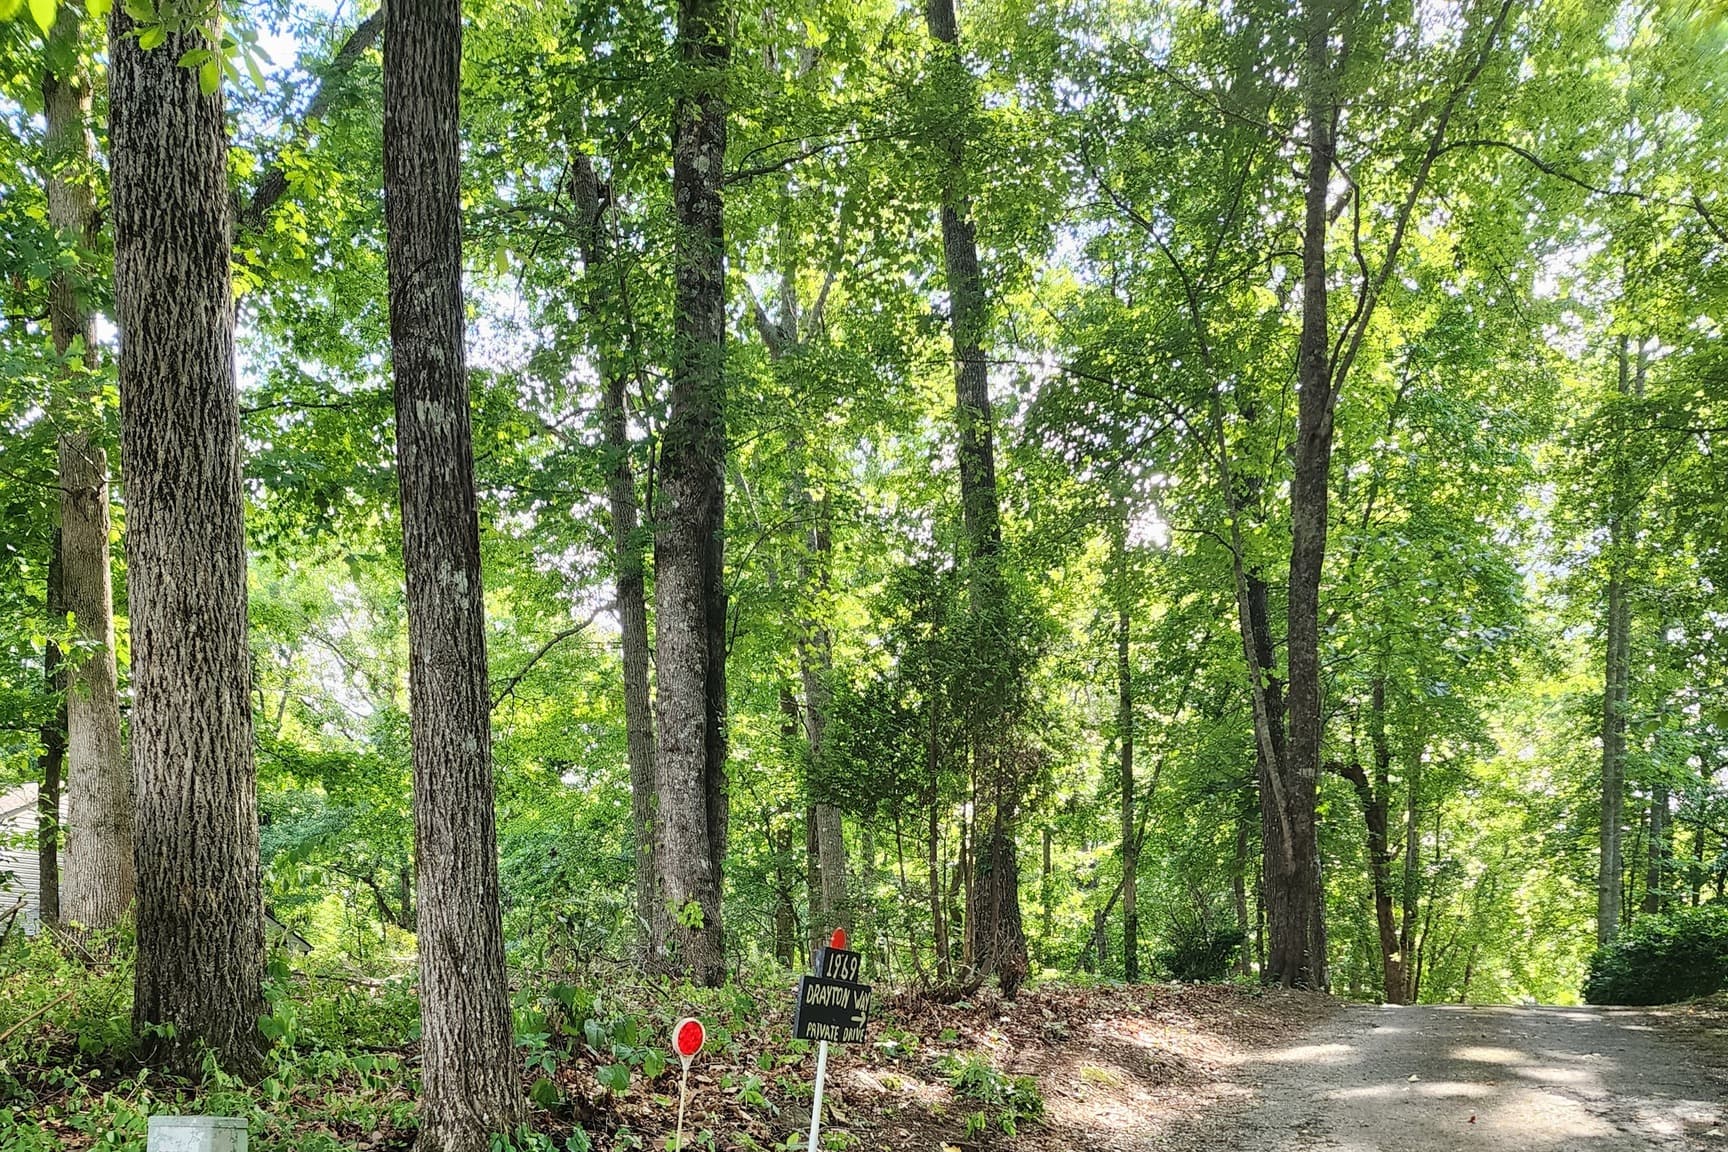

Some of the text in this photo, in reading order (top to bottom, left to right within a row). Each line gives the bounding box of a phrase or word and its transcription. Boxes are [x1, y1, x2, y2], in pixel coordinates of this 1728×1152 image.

[826, 953, 858, 980] 1969
[806, 984, 871, 1011] DRAYTON WAY
[806, 1022, 865, 1043] PRIVATE DRIVE
